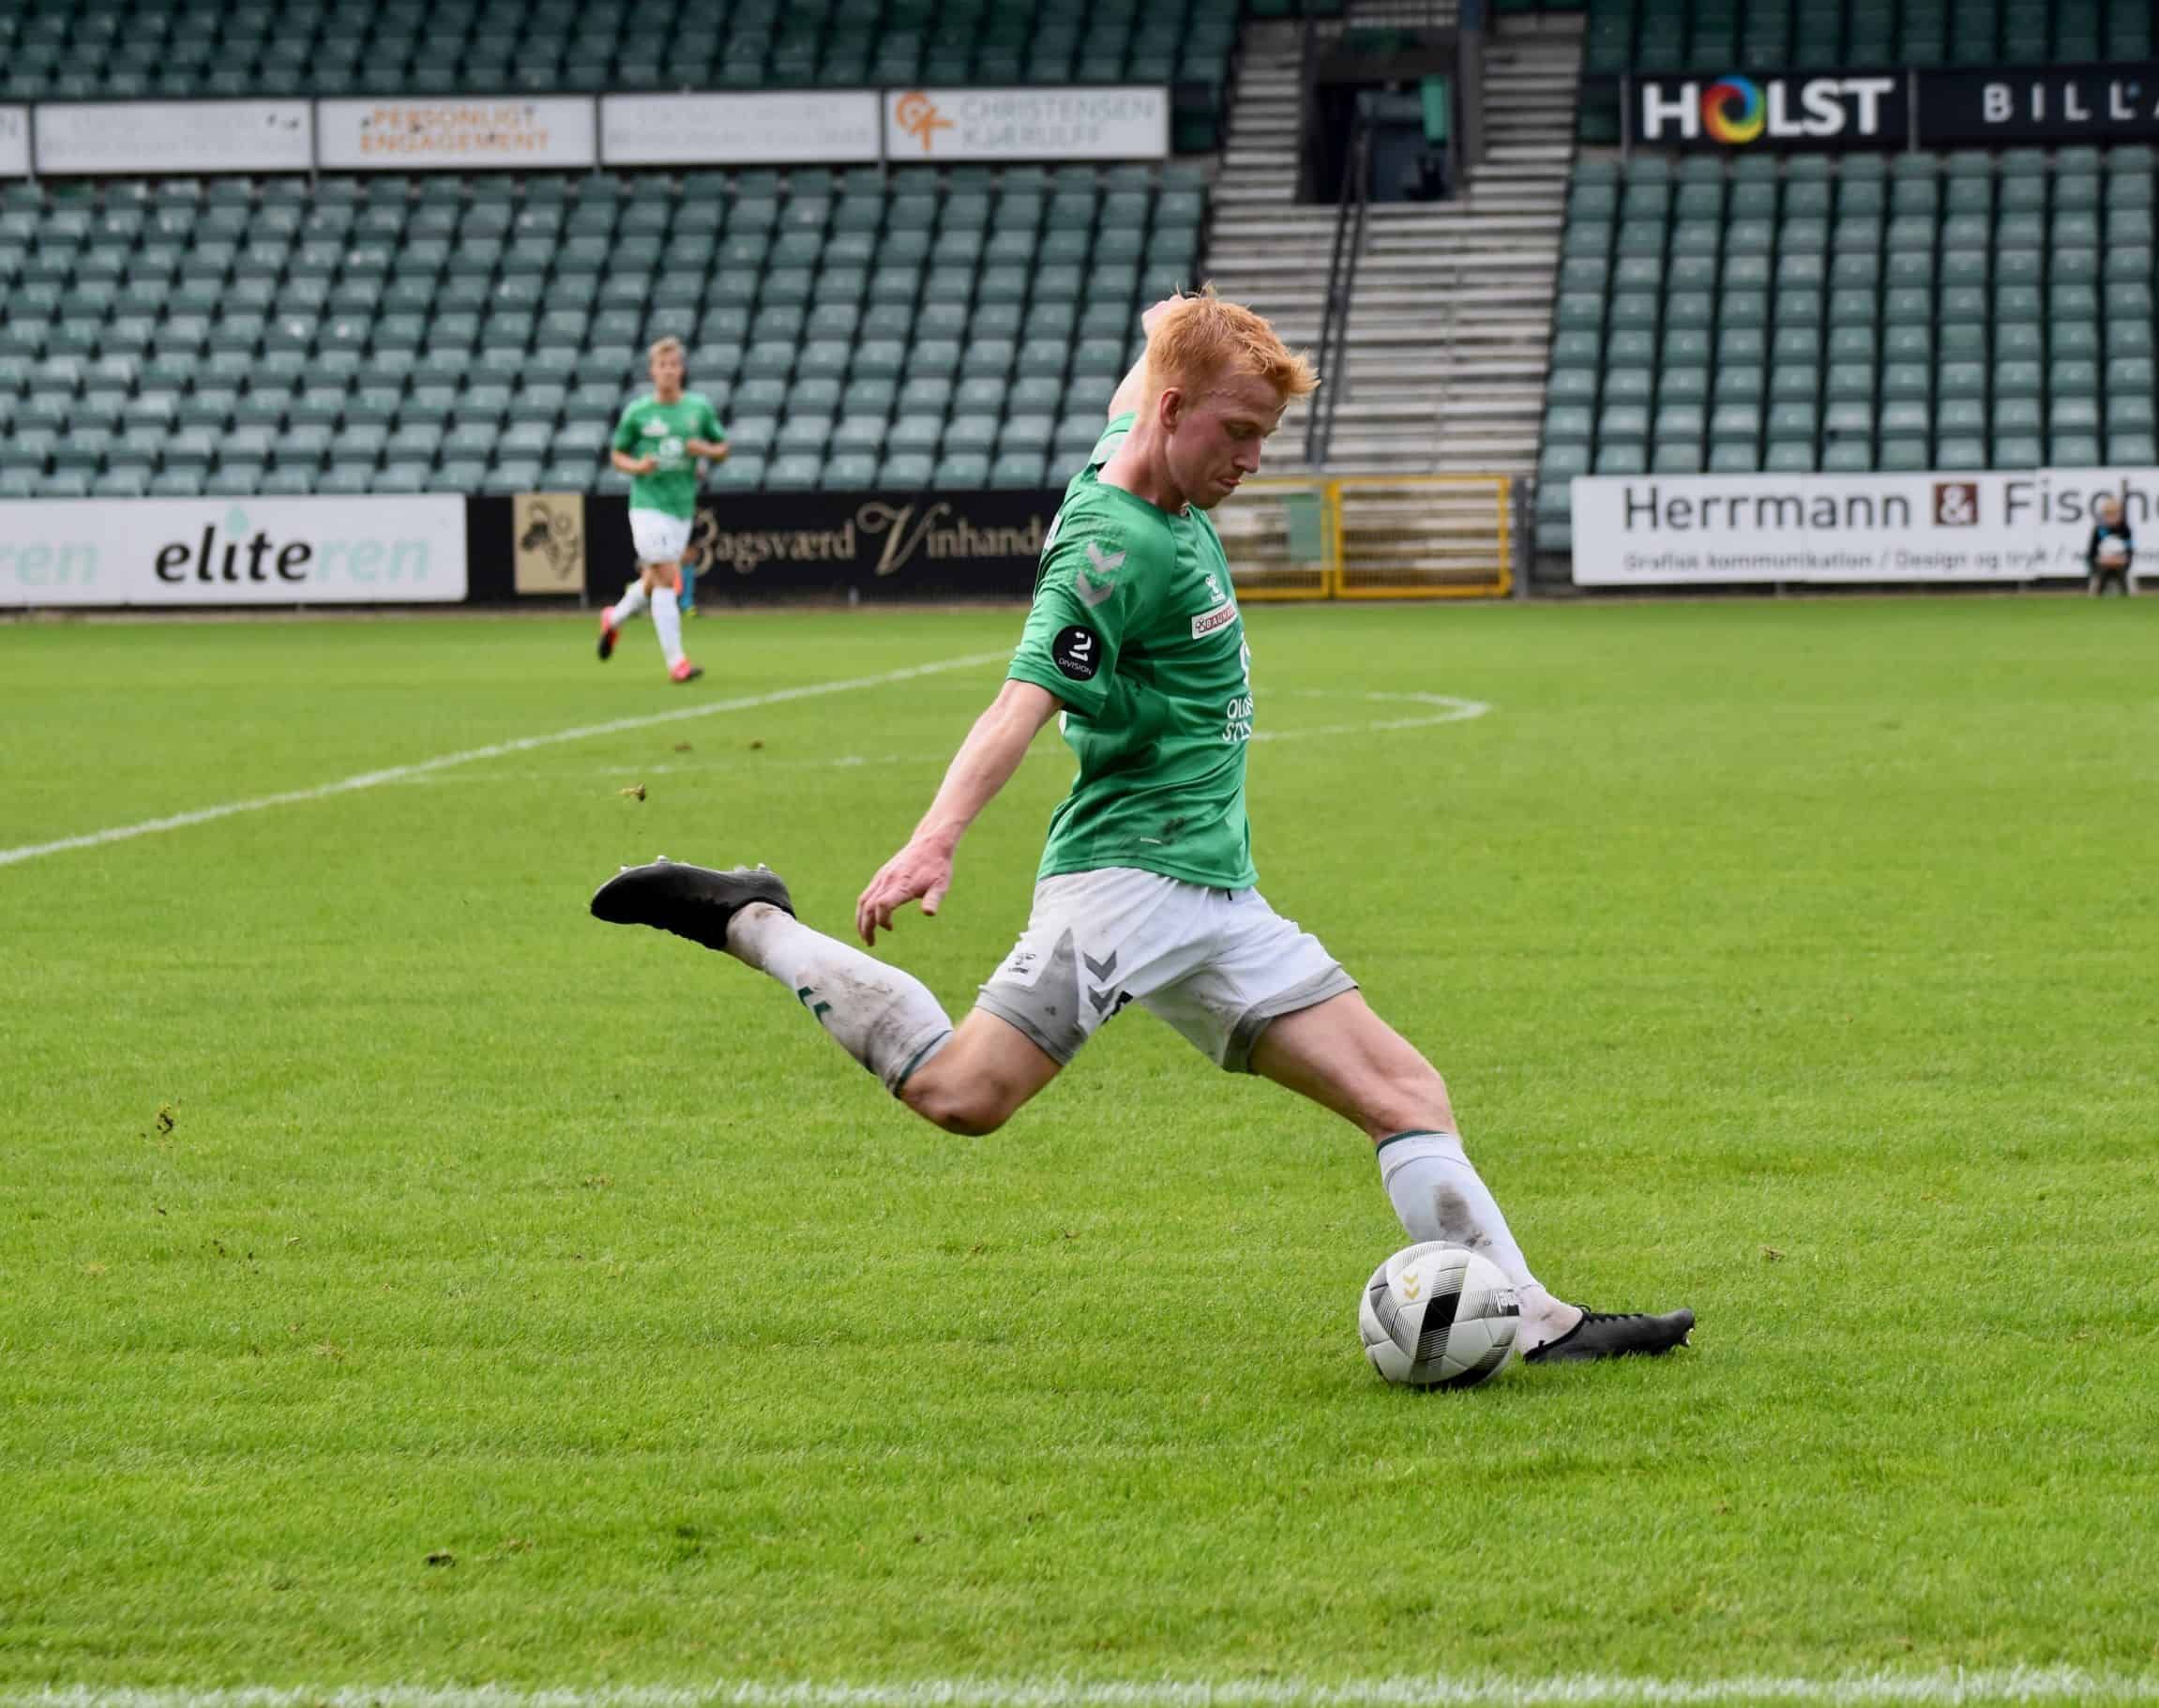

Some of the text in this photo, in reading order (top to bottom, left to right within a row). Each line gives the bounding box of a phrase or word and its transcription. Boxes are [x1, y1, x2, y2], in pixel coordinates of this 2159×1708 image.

[1642, 76, 1894, 143] HOLST
[360, 131, 550, 153] ENGAGEMENT
[1624, 485, 1910, 531] Herrmann
[2003, 476, 2159, 527] Fisch
[155, 506, 431, 583] eliteren
[856, 501, 1047, 576] Vinhand
[1059, 658, 1093, 675] DIVISION
